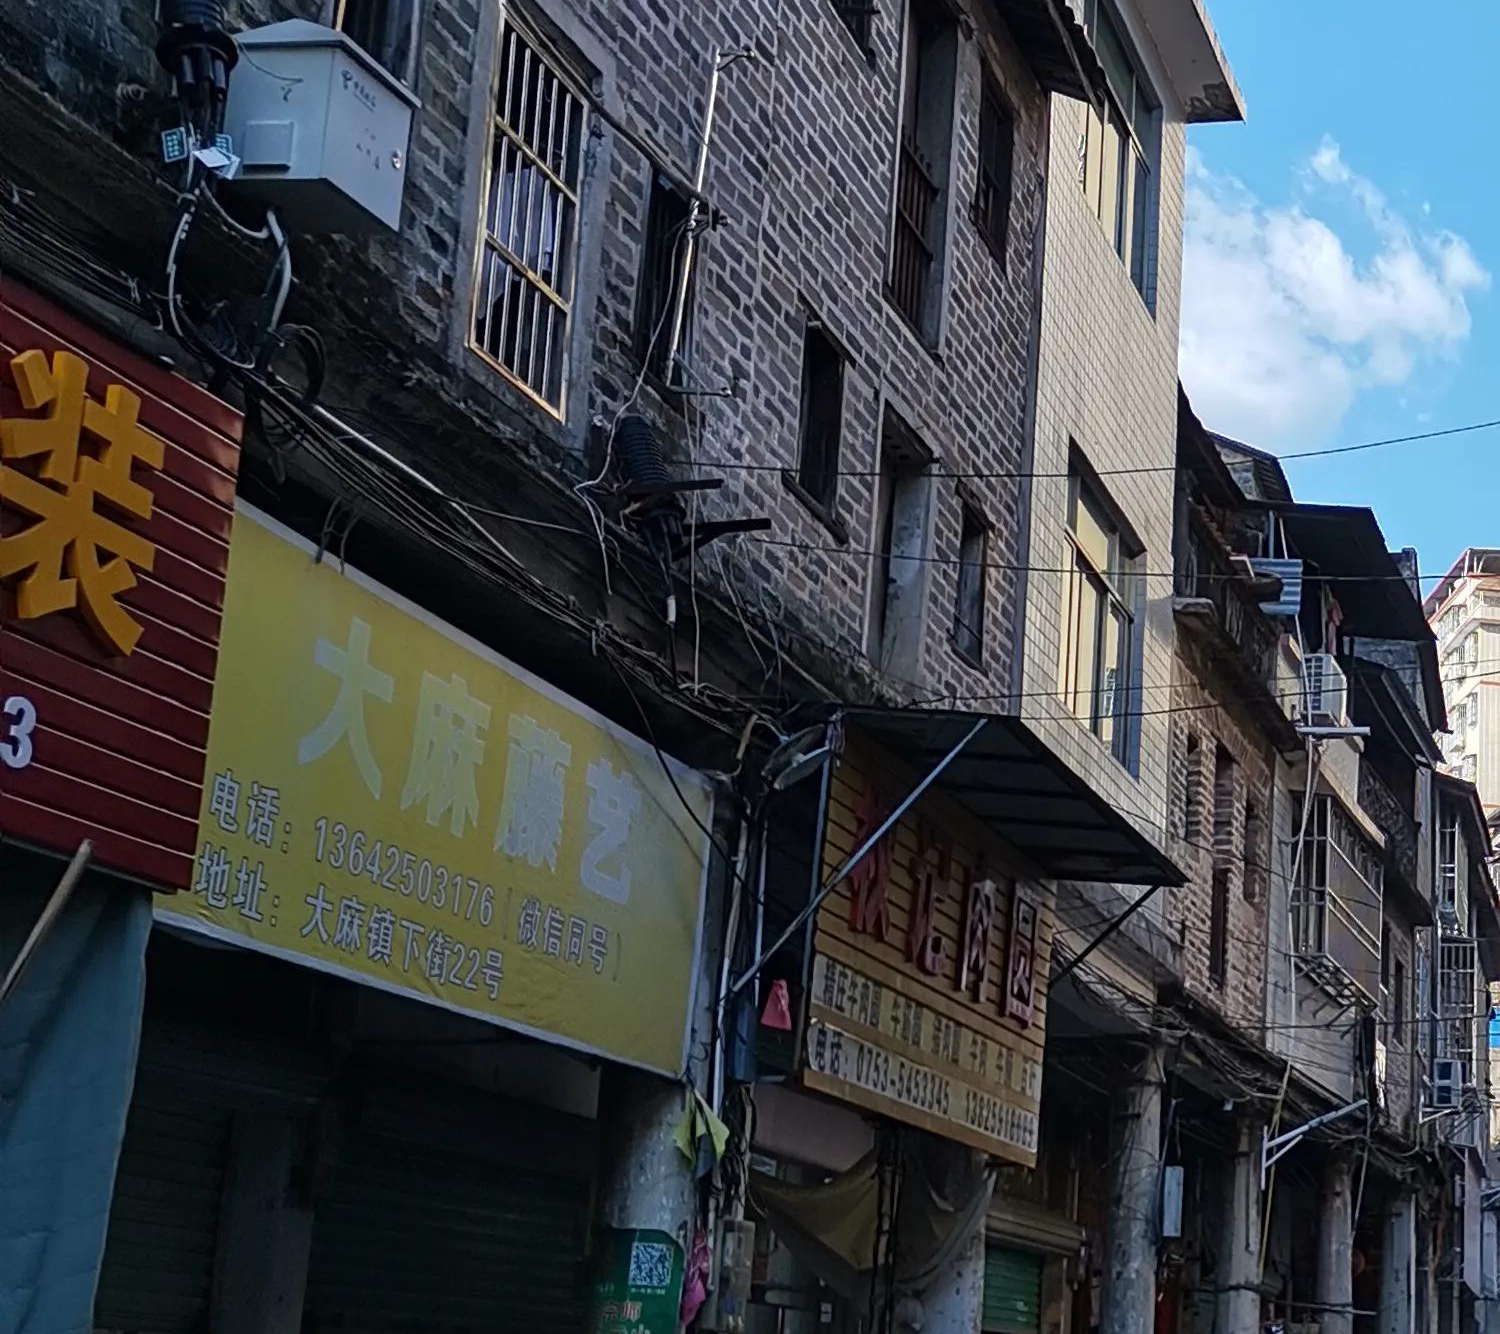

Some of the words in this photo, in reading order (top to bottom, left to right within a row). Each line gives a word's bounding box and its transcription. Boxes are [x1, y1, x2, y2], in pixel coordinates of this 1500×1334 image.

[0, 347, 166, 657] 装
[296, 615, 643, 905] 大麻藤艺
[301, 883, 506, 1001] 大麻镇下街22号
[314, 817, 496, 928] 13642503176
